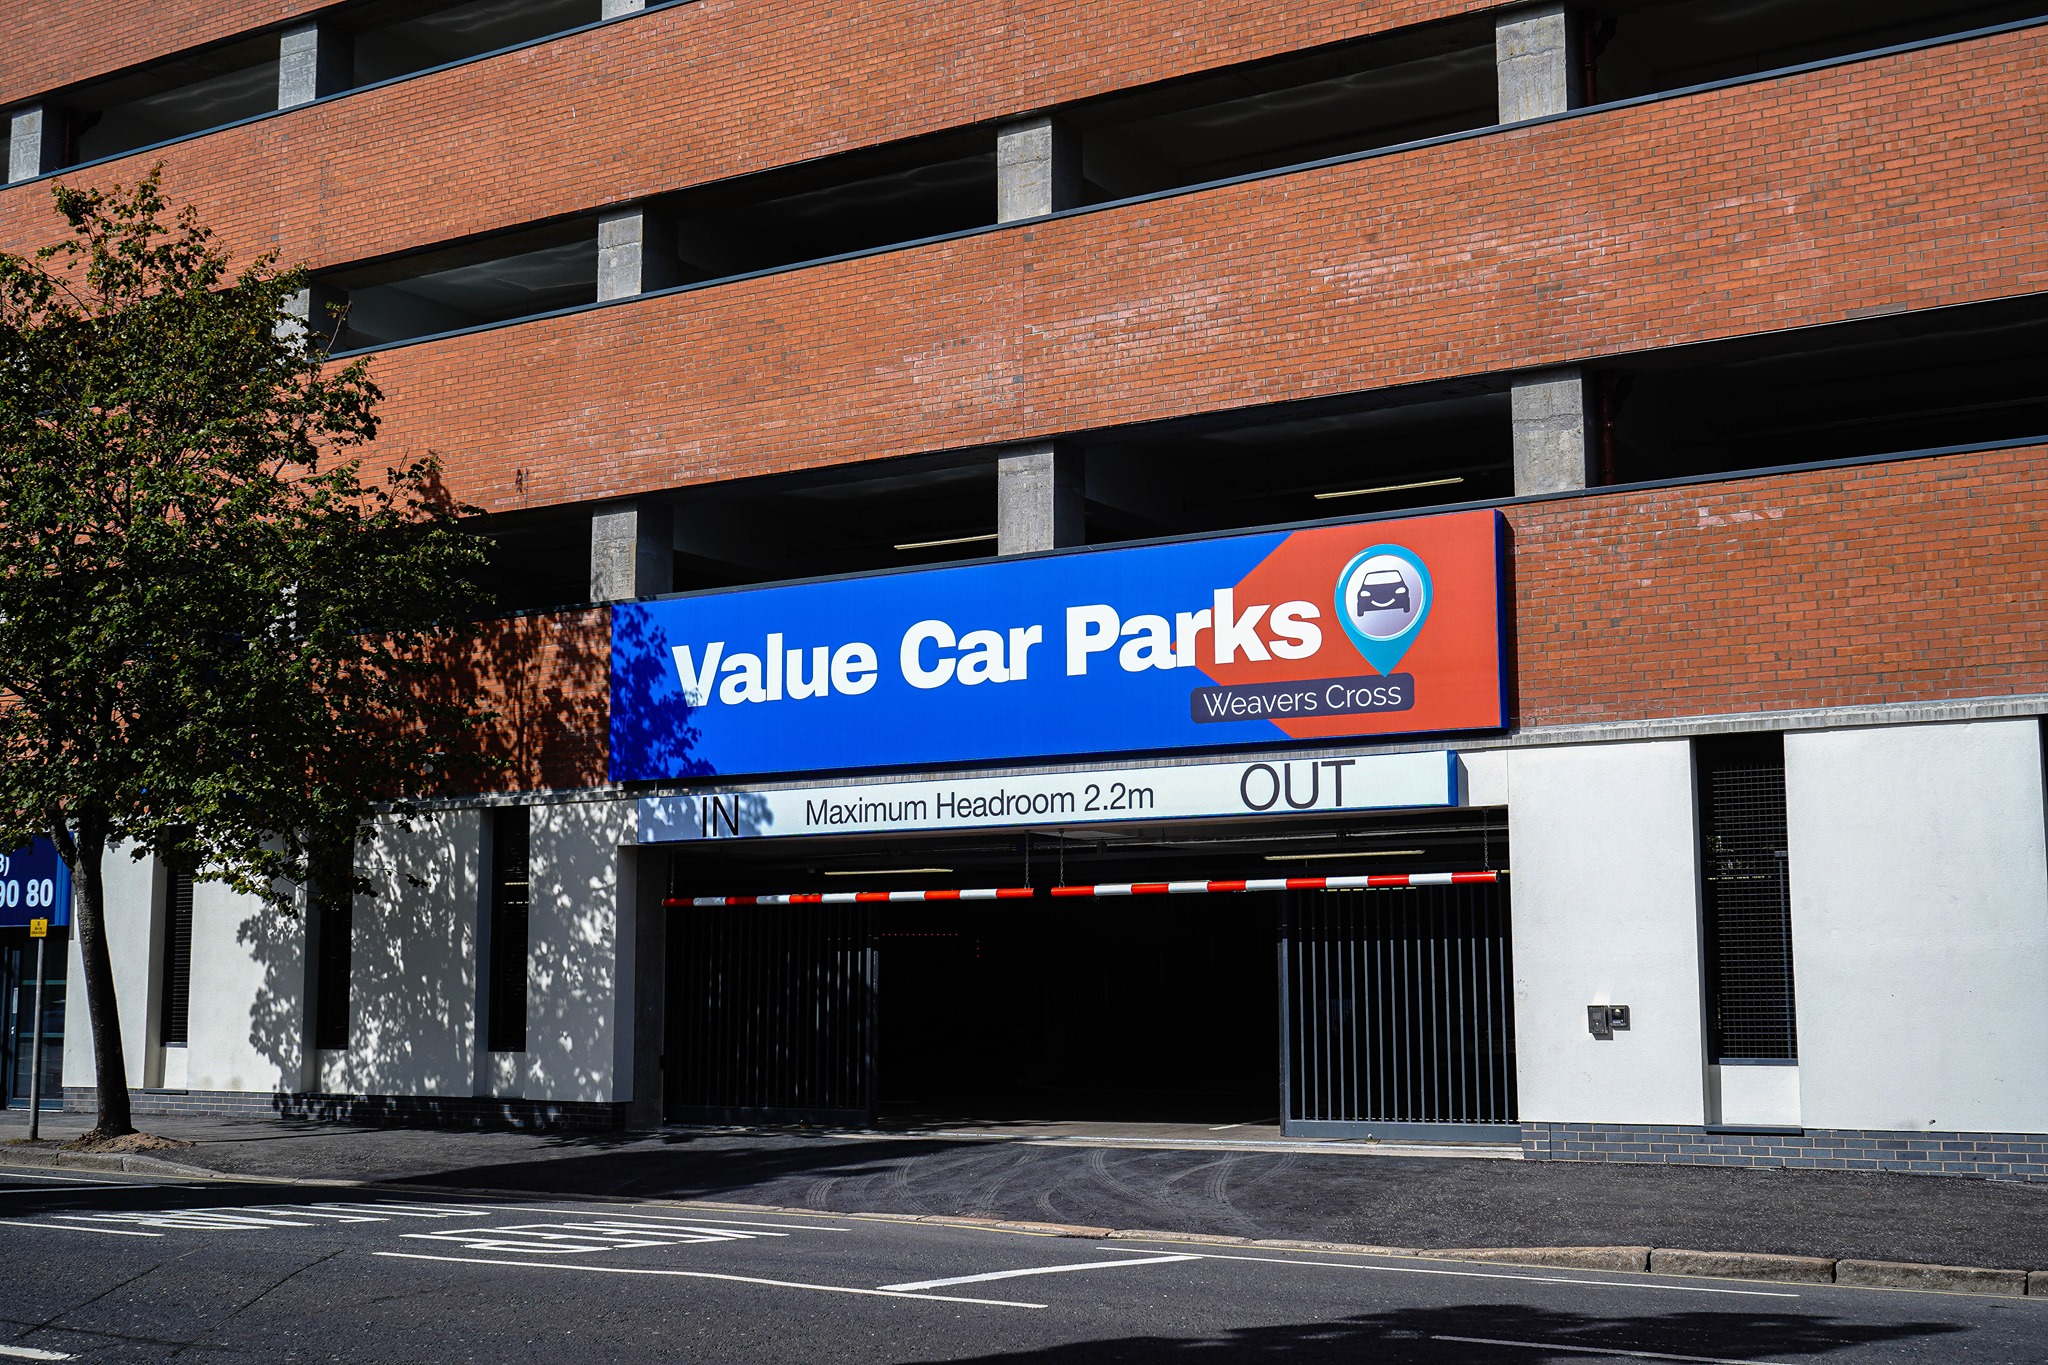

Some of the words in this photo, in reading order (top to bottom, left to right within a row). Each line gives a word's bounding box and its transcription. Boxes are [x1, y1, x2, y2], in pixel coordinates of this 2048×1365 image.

[672, 633, 877, 707] Value
[900, 620, 1043, 689] Car
[1066, 587, 1323, 677] Parks
[1202, 691, 1318, 717] Weavers
[1325, 684, 1402, 709] Cross
[805, 797, 928, 825] Maximum
[936, 789, 1075, 819] Headroom
[1083, 782, 1154, 813] 2.2m
[1240, 759, 1356, 811] OUT
[701, 796, 739, 838] IN
[26, 878, 54, 907] 80
[53, 1202, 493, 1230] CLEAR
[399, 1220, 791, 1254] KEEP
